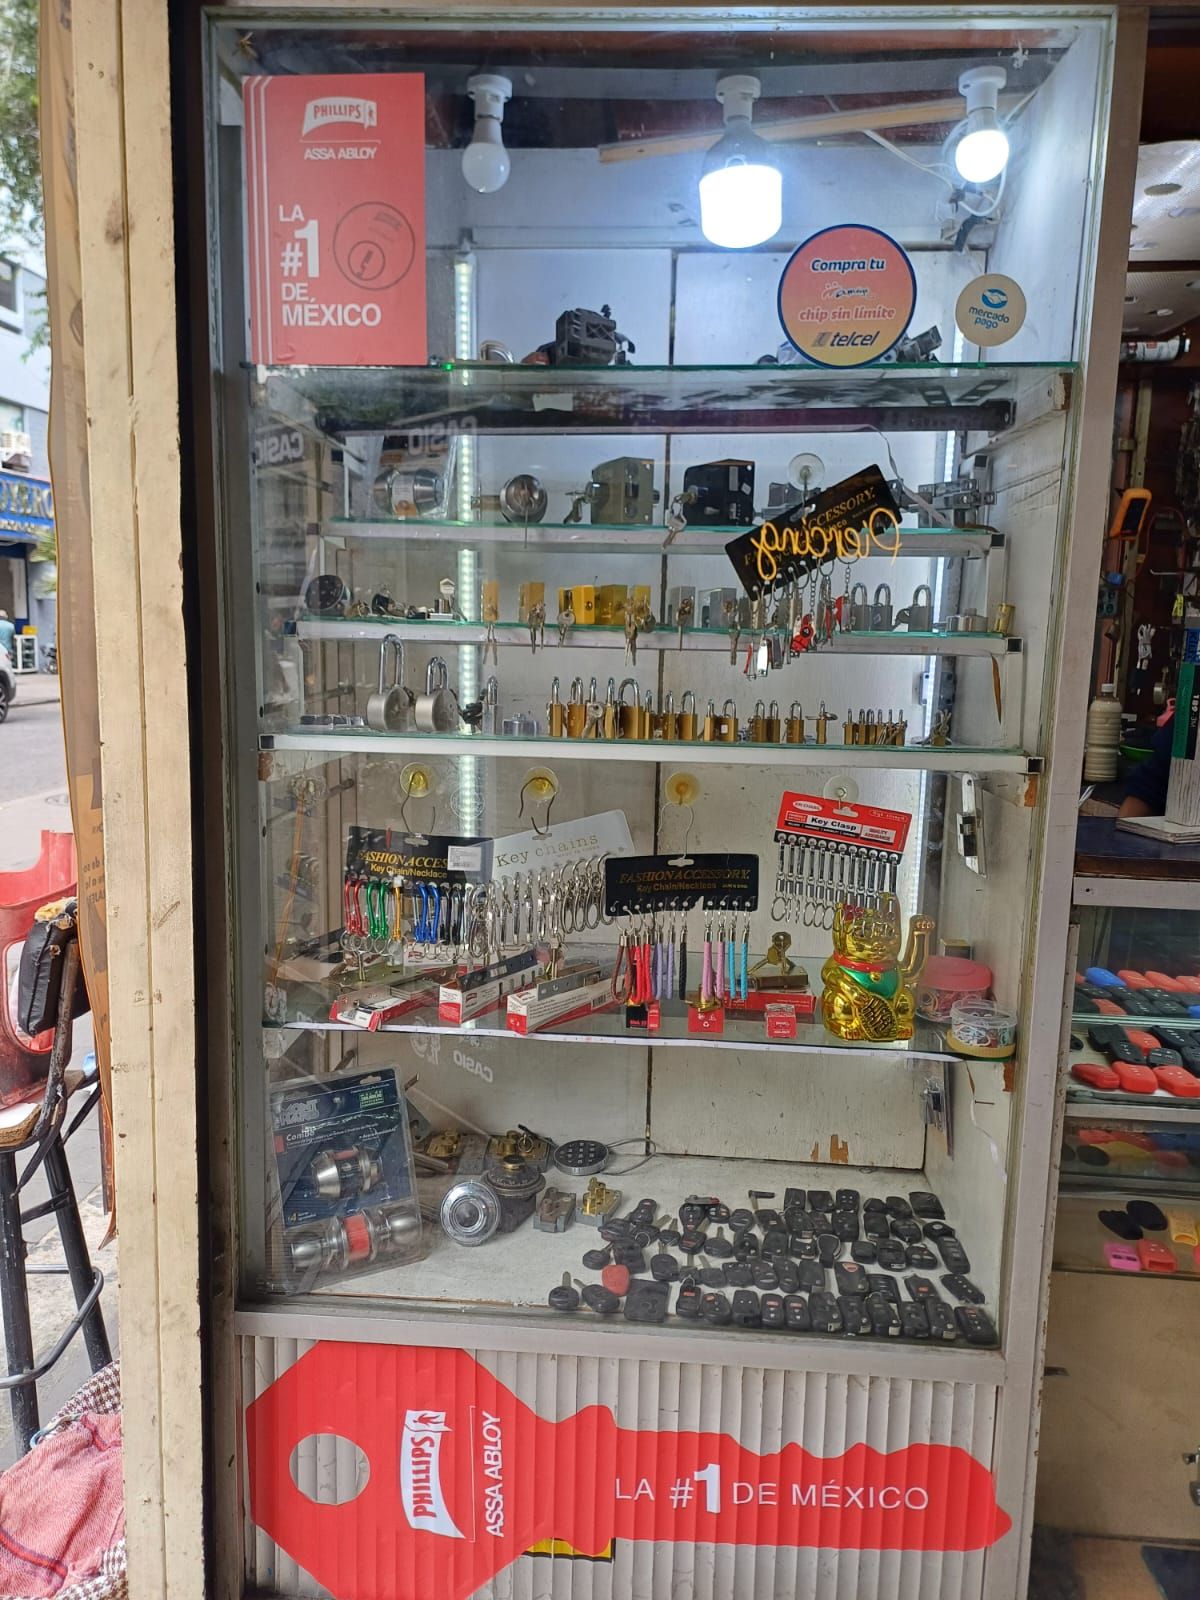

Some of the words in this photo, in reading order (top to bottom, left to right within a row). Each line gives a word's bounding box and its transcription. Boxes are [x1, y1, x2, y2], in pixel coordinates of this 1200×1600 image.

[313, 104, 361, 119] PHILLIPS
[304, 147, 336, 160] ASSA
[338, 147, 377, 160] ABLOY
[279, 205, 305, 222] LA
[281, 220, 320, 278] #1
[811, 258, 865, 273] Compra
[869, 258, 885, 271] tu
[282, 283, 308, 301] DE
[282, 298, 382, 327] MÉXICO
[800, 308, 828, 322] chip
[831, 307, 851, 319] sin
[969, 306, 1010, 323] mercado
[975, 316, 999, 329] pago
[830, 331, 881, 347] telcel
[797, 487, 876, 538] CCESSORY.
[810, 816, 829, 826] Key
[831, 820, 857, 831] Clasp
[496, 851, 529, 867] Key
[535, 835, 599, 857] chains
[370, 863, 385, 874] Key
[619, 870, 674, 884] FASHION
[482, 1410, 503, 1481] ABLOY
[410, 1435, 437, 1518] PHILLIPS
[615, 1478, 655, 1501] LA
[669, 1463, 721, 1514] #1
[732, 1481, 777, 1506] DE
[792, 1479, 929, 1510] MÉXICO
[484, 1482, 504, 1538] ASSA
